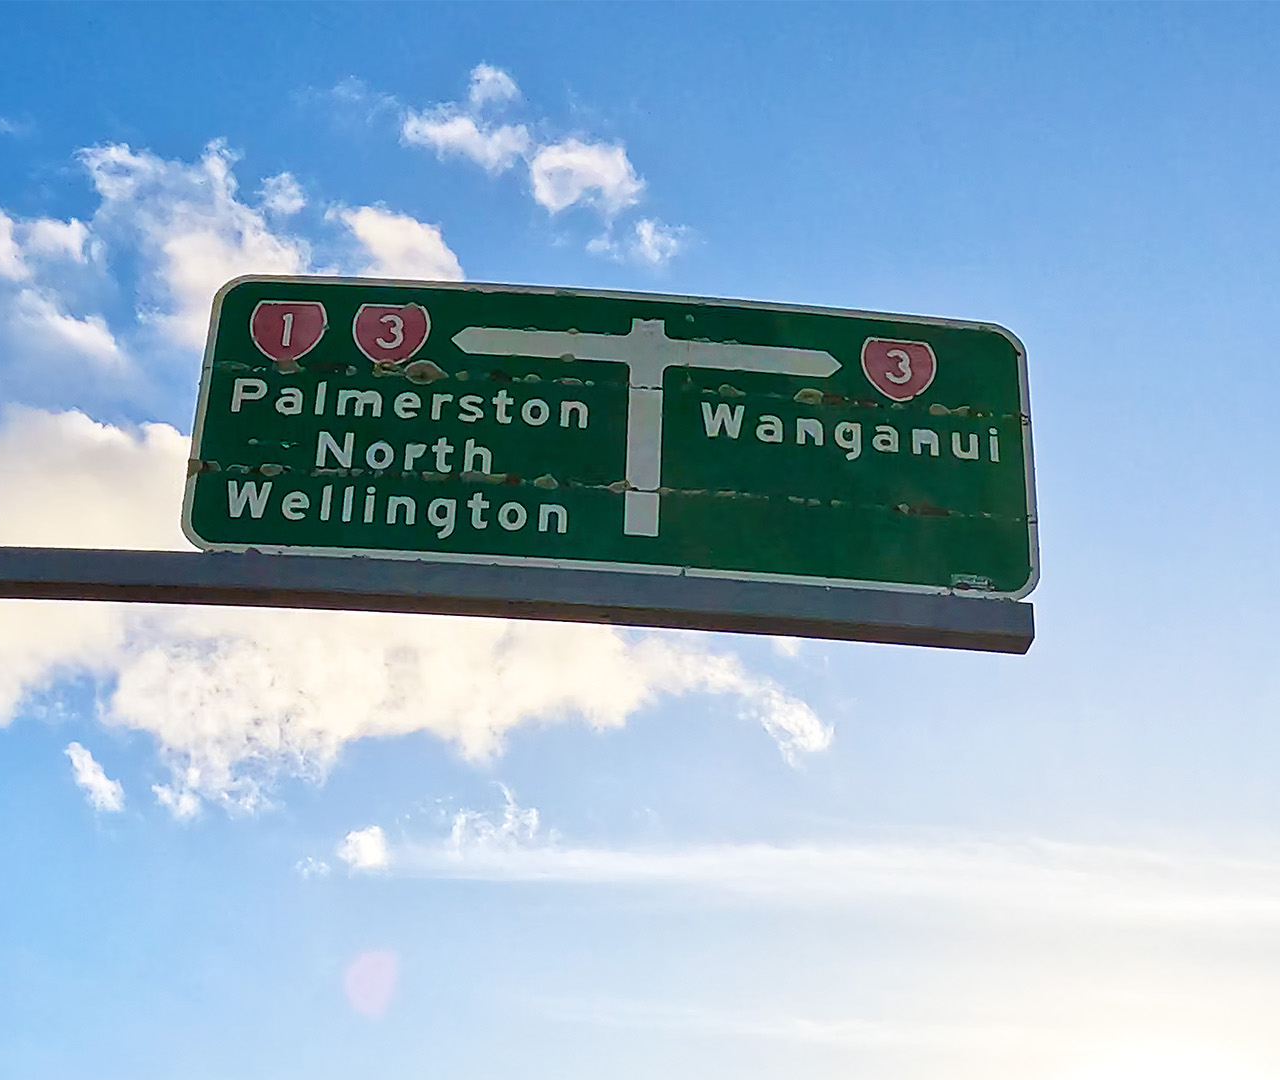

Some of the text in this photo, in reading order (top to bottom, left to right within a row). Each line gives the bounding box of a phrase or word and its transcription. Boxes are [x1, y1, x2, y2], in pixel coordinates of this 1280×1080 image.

[281, 312, 405, 347] 1 3
[885, 349, 912, 386] 3
[231, 377, 589, 430] Palmerston
[317, 430, 494, 475] North
[701, 401, 1003, 463] Wanganui
[227, 479, 569, 539] Wellington
